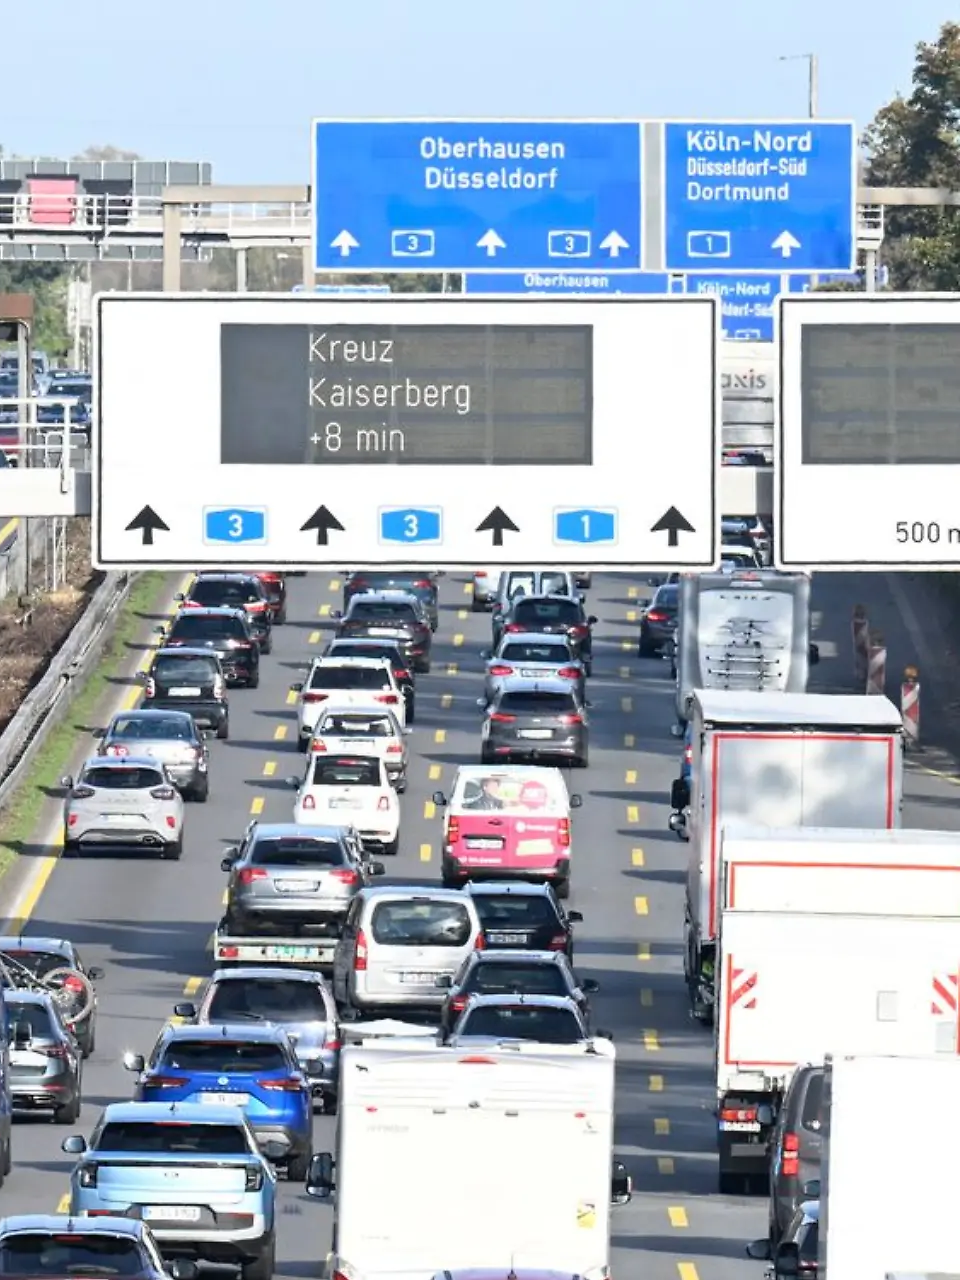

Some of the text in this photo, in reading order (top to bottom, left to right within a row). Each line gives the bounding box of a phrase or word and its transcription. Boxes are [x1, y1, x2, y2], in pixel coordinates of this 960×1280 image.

[420, 136, 565, 159] Oberhausen
[687, 130, 813, 152] Köln-Nord
[424, 167, 559, 189] Düsseldorf
[687, 157, 807, 176] Düsseldorf-Süd
[687, 181, 789, 201] Dortmund
[408, 235, 419, 251] 3
[565, 235, 575, 252] 3
[523, 273, 609, 288] Oberhausen
[309, 332, 394, 363] Kreuz
[309, 377, 471, 415] Kaiserberg
[309, 422, 405, 452] +8 min
[228, 514, 243, 538] 3
[403, 514, 419, 538] 3
[579, 514, 590, 538] 1
[895, 521, 941, 544] 500
